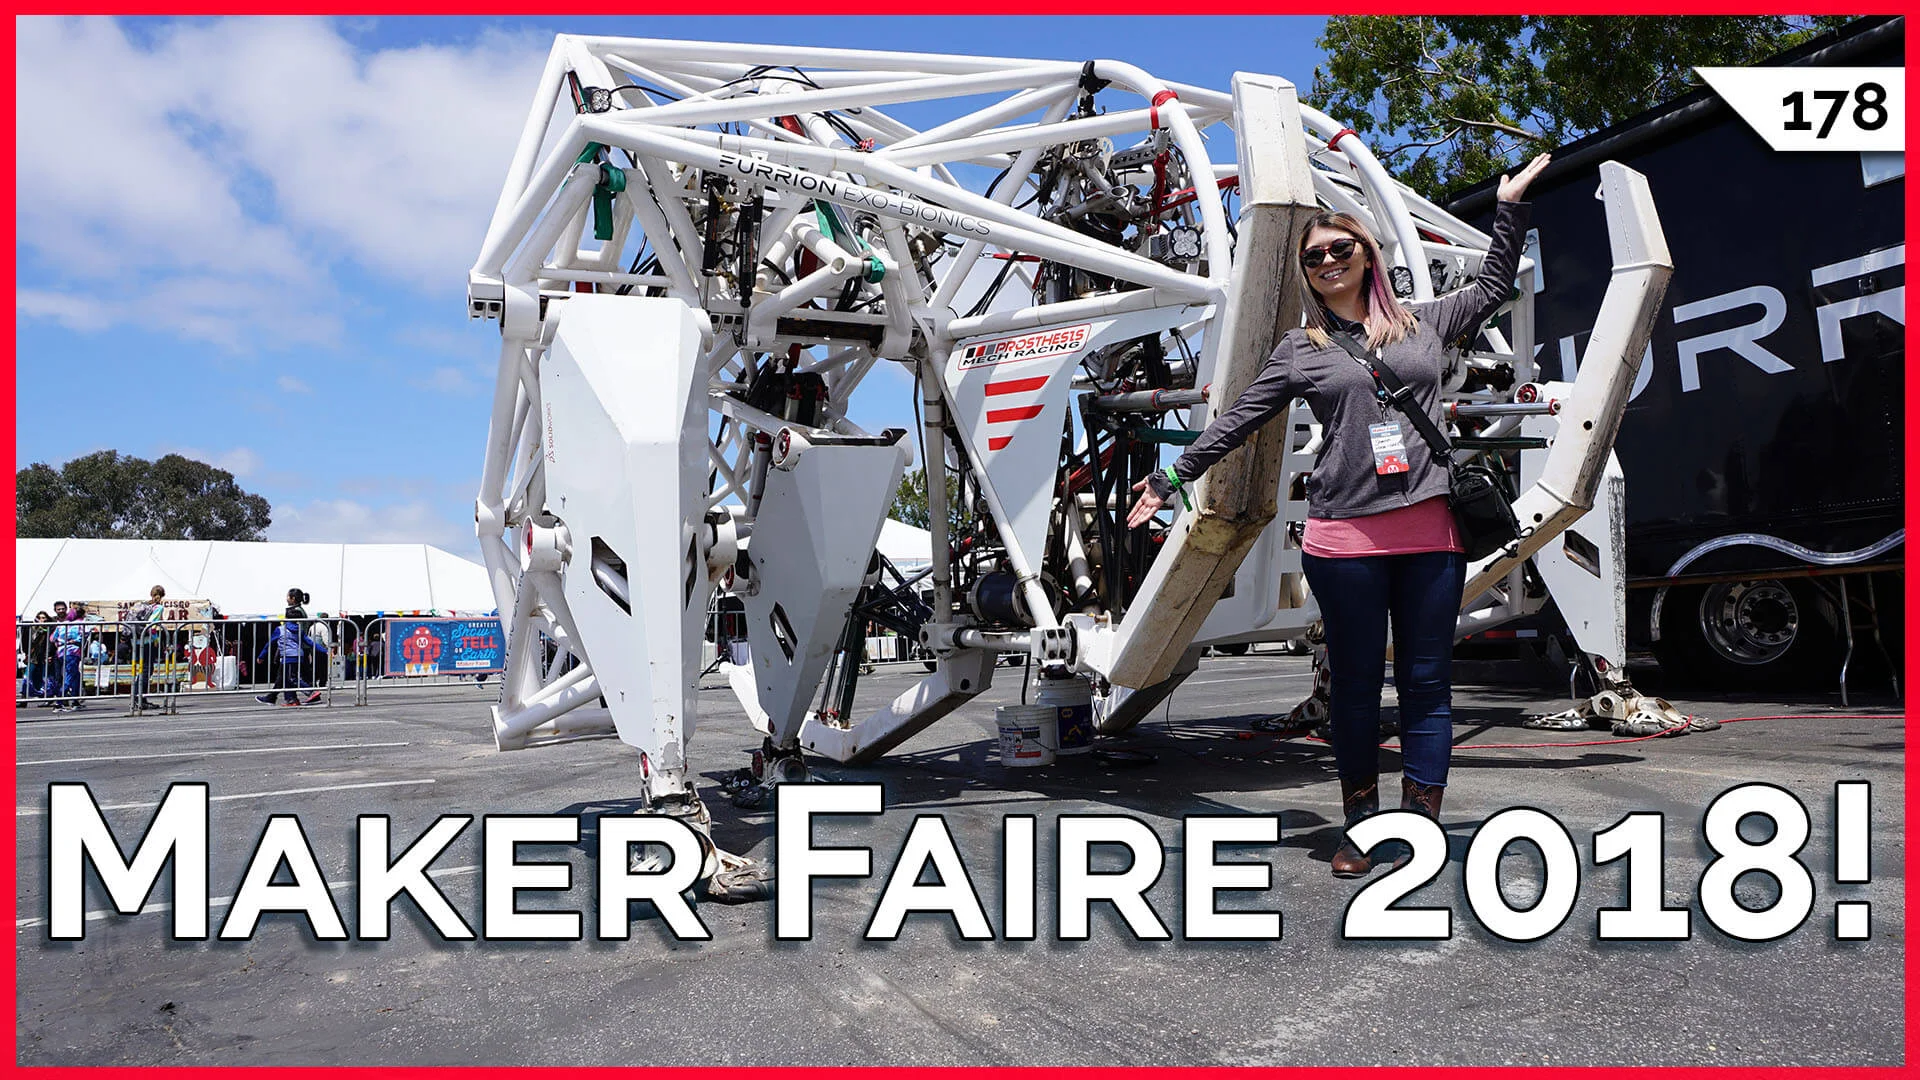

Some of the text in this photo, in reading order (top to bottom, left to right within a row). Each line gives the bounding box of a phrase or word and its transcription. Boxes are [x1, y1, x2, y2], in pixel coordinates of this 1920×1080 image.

[719, 154, 992, 236] FURRION EXO-BIONICS
[995, 329, 1085, 354] PROSTHESIS
[963, 341, 1080, 366] MECH RACING
[451, 624, 489, 641] Show
[461, 636, 498, 649] TELL
[461, 648, 497, 661] Earth
